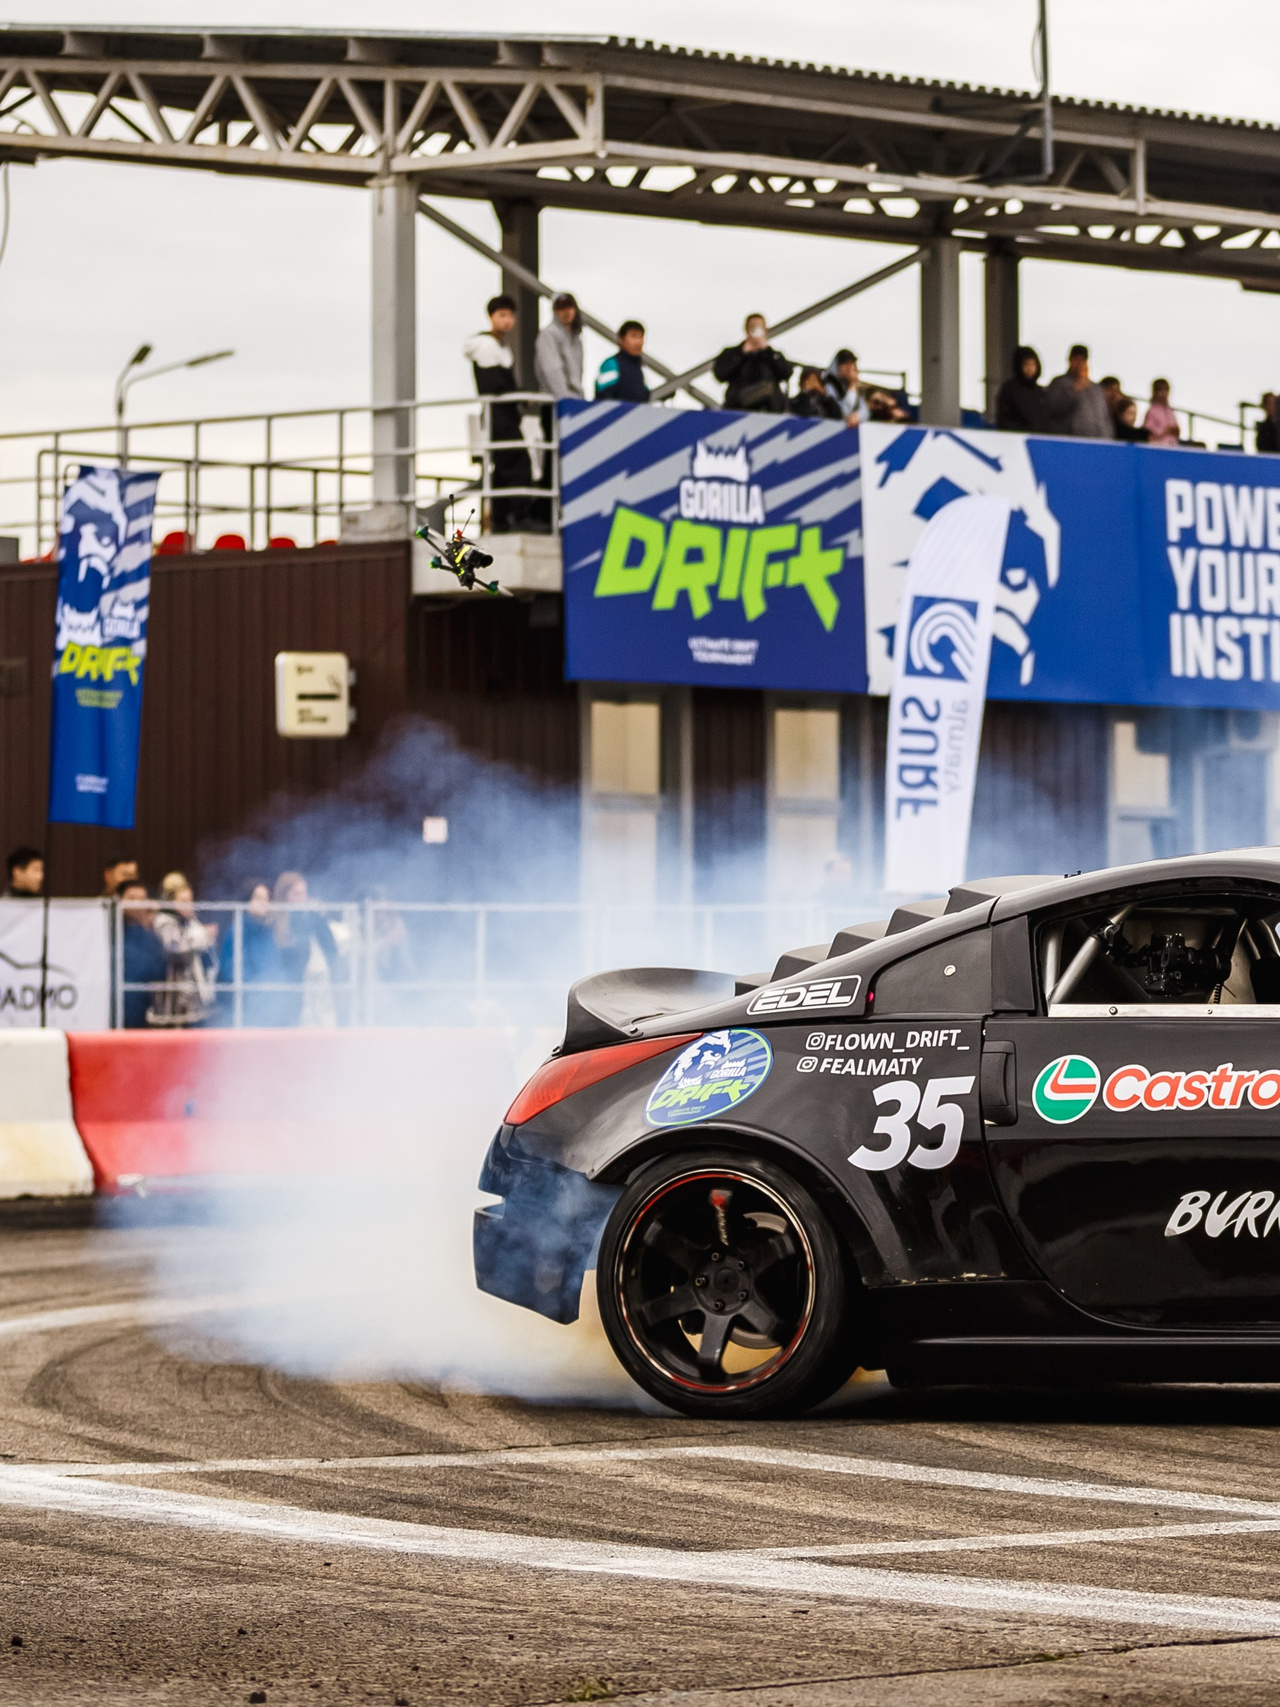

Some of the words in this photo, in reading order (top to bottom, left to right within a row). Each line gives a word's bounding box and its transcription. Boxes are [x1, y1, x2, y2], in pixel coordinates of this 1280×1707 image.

[680, 479, 765, 524] GORILLA
[594, 506, 845, 632] DRIFT
[59, 640, 141, 686] DRIFT
[753, 980, 854, 1011] EDEL
[824, 1029, 970, 1054] FLOWN_DRIFT_
[709, 1066, 747, 1080] GORILLA
[819, 1057, 923, 1076] FEALMATY
[648, 1079, 751, 1112] DRIFT
[847, 1076, 976, 1171] 35
